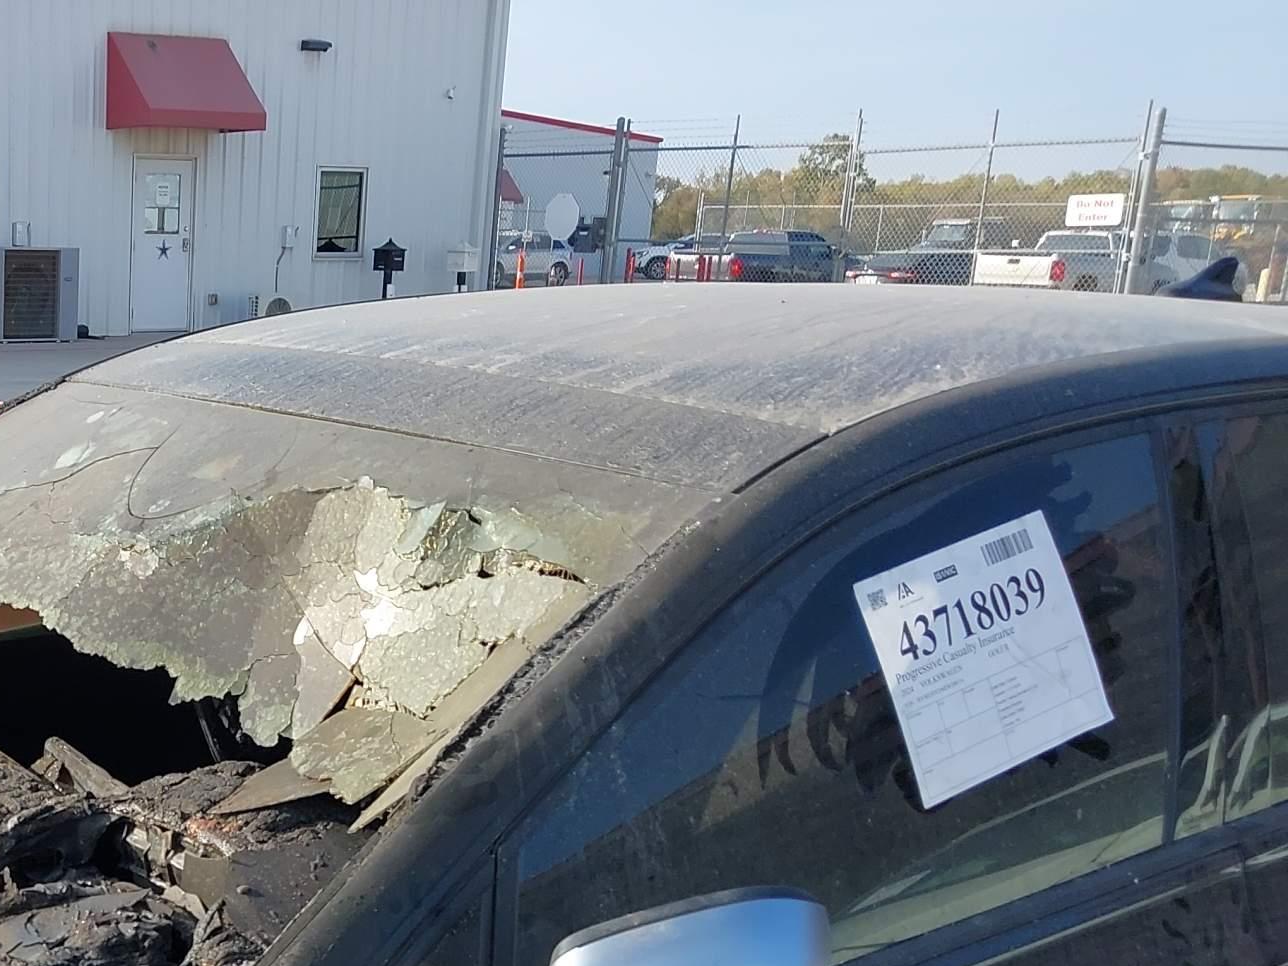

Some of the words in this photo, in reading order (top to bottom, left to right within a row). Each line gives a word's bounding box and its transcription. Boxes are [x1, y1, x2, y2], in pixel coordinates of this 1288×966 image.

[1076, 200, 1091, 209] Do
[1094, 199, 1115, 208] Not
[1078, 212, 1108, 222] Enter
[899, 567, 1046, 661] 43718039
[896, 656, 943, 685] Progressive
[942, 642, 977, 664] Casualty
[978, 626, 1015, 648] Insurance
